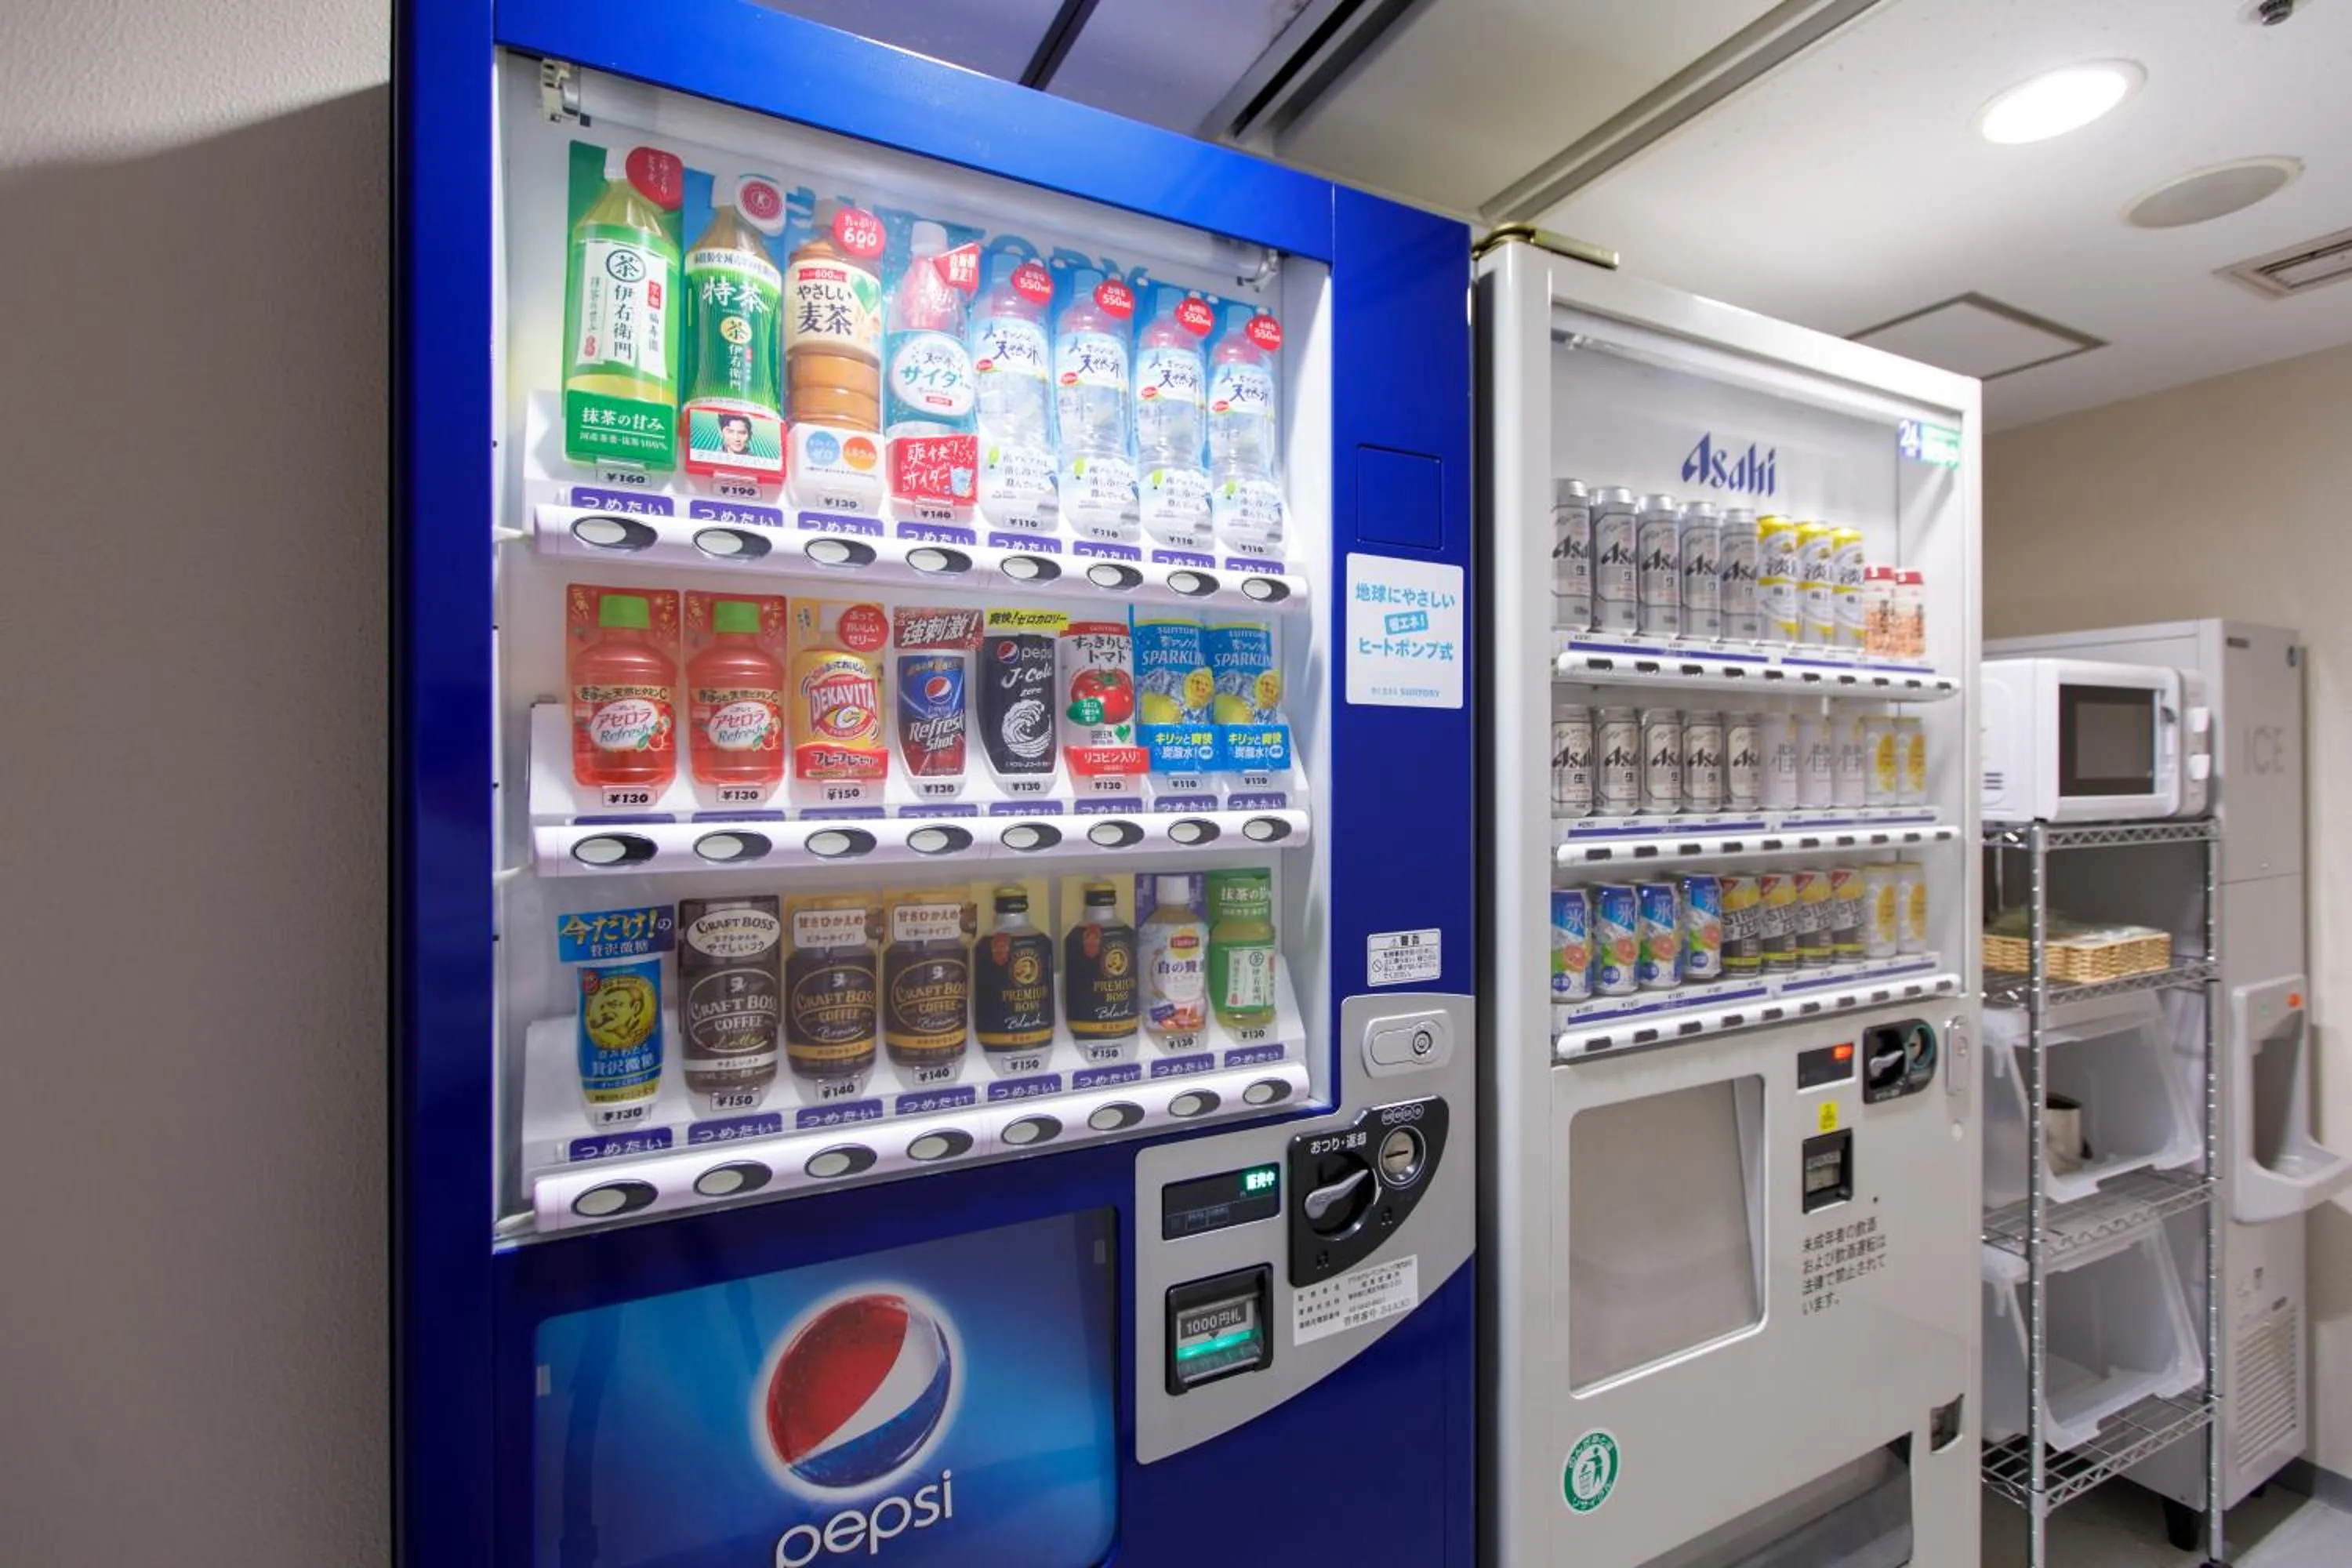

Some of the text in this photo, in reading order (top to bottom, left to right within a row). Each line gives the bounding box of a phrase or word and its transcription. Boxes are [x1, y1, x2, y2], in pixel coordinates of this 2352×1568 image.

[844, 227, 877, 247] 600
[615, 254, 639, 278] 茶
[797, 283, 852, 301] やさしい
[1019, 278, 1051, 294] 550ml
[702, 276, 770, 314] 特茶
[1102, 295, 1132, 309] 550ml
[614, 285, 633, 360] 伊右衛門
[797, 301, 853, 336] 麦茶
[1184, 312, 1212, 326] 550ml
[728, 319, 747, 341] 茶
[1254, 329, 1280, 343] 550ml
[993, 340, 1042, 366] 天然水
[728, 344, 743, 392] 伊右衛門
[1080, 354, 1120, 378] 天然水
[1159, 369, 1198, 392] 天然水
[1229, 384, 1269, 408] 天然水
[582, 407, 666, 430] 抹茶の甘み
[1899, 420, 1918, 449] 24
[1681, 431, 1776, 497] Asahi
[605, 472, 646, 485] ¥160
[720, 485, 756, 497] ¥190
[581, 495, 666, 515] つめたい
[699, 508, 775, 526] つめたい
[805, 519, 877, 536] つめたい
[905, 530, 971, 546] つめたい
[996, 539, 1054, 553] つめたい
[1078, 548, 1137, 561] つめたい
[1158, 556, 1211, 569] つめたい
[1230, 564, 1281, 576] つめたい
[1356, 582, 1456, 609] 地球にやさしい
[901, 612, 980, 648] 強刺激!
[1088, 650, 1127, 664] トマト
[1359, 637, 1454, 661] ヒートポンプ式
[811, 682, 877, 720] DEKAVITA
[1399, 688, 1440, 697] SUNTORY
[596, 707, 652, 731] アセロラ
[713, 710, 766, 730] アセロラ
[599, 724, 650, 743] Refresh
[717, 726, 764, 743] Refresh
[1154, 732, 1214, 745] キリッと爽快
[1228, 731, 1283, 745] キリッと爽快
[608, 792, 649, 804] ¥130
[721, 789, 759, 801] ¥130
[827, 789, 861, 802] ¥150
[695, 916, 775, 934] CRAFT BOSS
[798, 914, 865, 930] 甘さひかえめ
[898, 909, 960, 924] 甘さひかえめ
[560, 908, 673, 946] 今だけ!の
[591, 942, 650, 957] 贅沢微糖
[797, 991, 842, 1010] CRAFT
[896, 983, 941, 1001] CRAFT
[690, 996, 742, 1019] CRAFT
[818, 1008, 861, 1022] COFFEE
[918, 1000, 957, 1014] COFFEE
[714, 1015, 764, 1032] COFFEE
[1091, 1048, 1119, 1059] ¥150
[1229, 1051, 1280, 1064] つめたい
[592, 1056, 655, 1076] 贅沢微糖
[1010, 1060, 1040, 1071] ¥150
[1156, 1062, 1211, 1075] つめたい
[919, 1069, 950, 1082] ¥140
[1079, 1070, 1136, 1086] つめたい
[822, 1084, 855, 1098] ¥140
[995, 1083, 1054, 1098] つめたい
[717, 1094, 754, 1107] ¥150
[903, 1094, 970, 1111] つめたい
[603, 1106, 644, 1121] ¥130
[804, 1108, 875, 1125] つめたい
[699, 1123, 776, 1140] つめたい
[580, 1138, 664, 1158] つめたい
[1310, 1132, 1367, 1155] おつり・返却
[1186, 1310, 1242, 1335] 1000円札
[774, 1469, 953, 1568] pepsi
